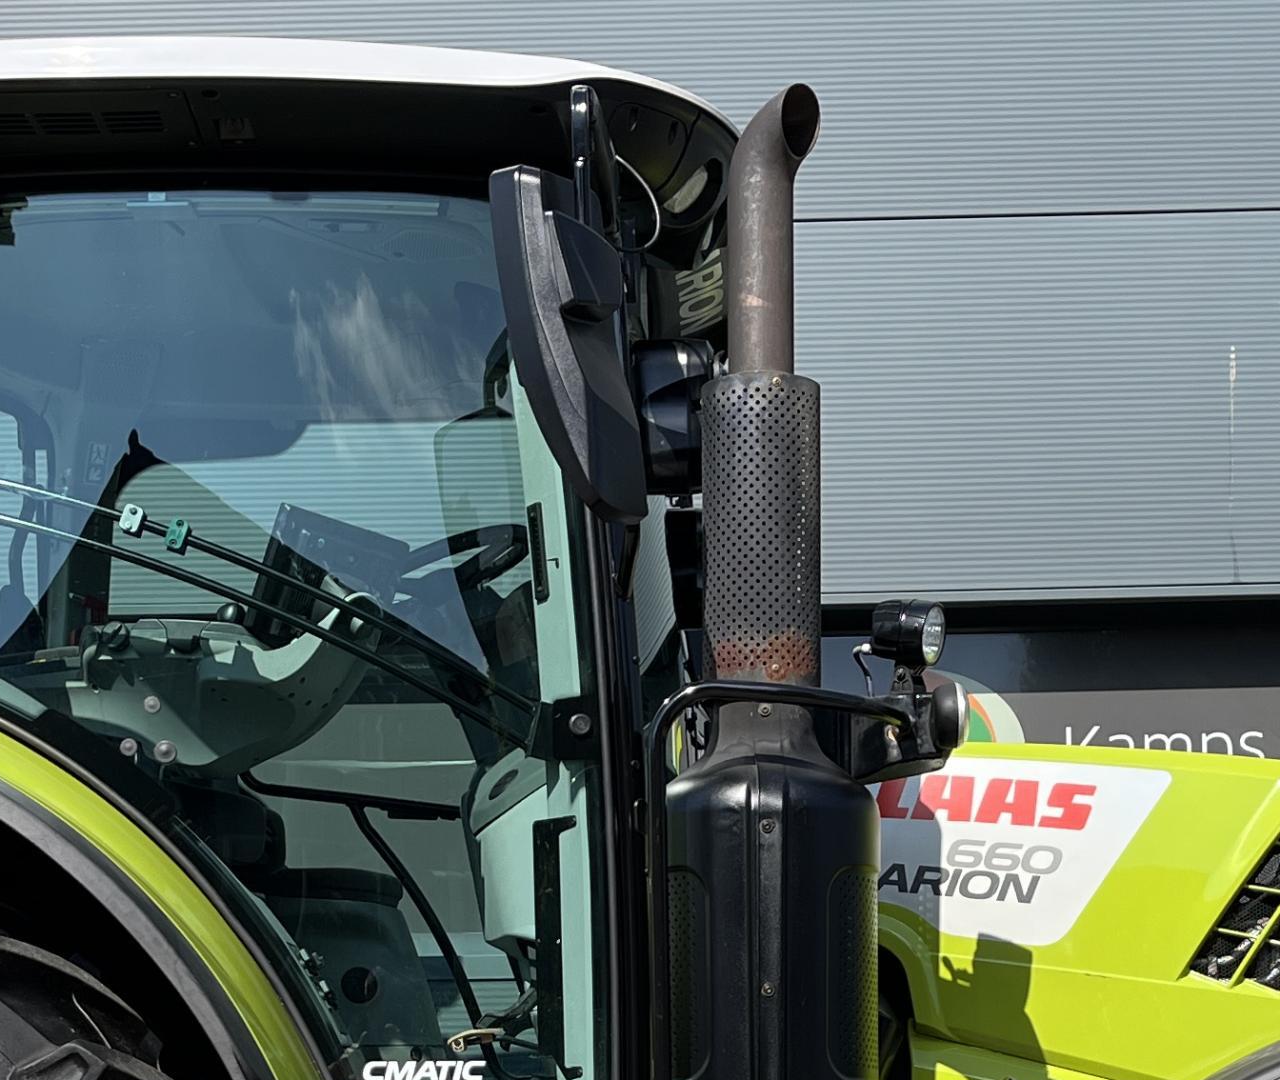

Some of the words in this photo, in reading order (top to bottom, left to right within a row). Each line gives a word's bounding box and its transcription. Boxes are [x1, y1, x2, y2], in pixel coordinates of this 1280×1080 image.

[876, 775, 1098, 831] LAAS
[946, 839, 1064, 875] 660
[878, 863, 1041, 904] ARION
